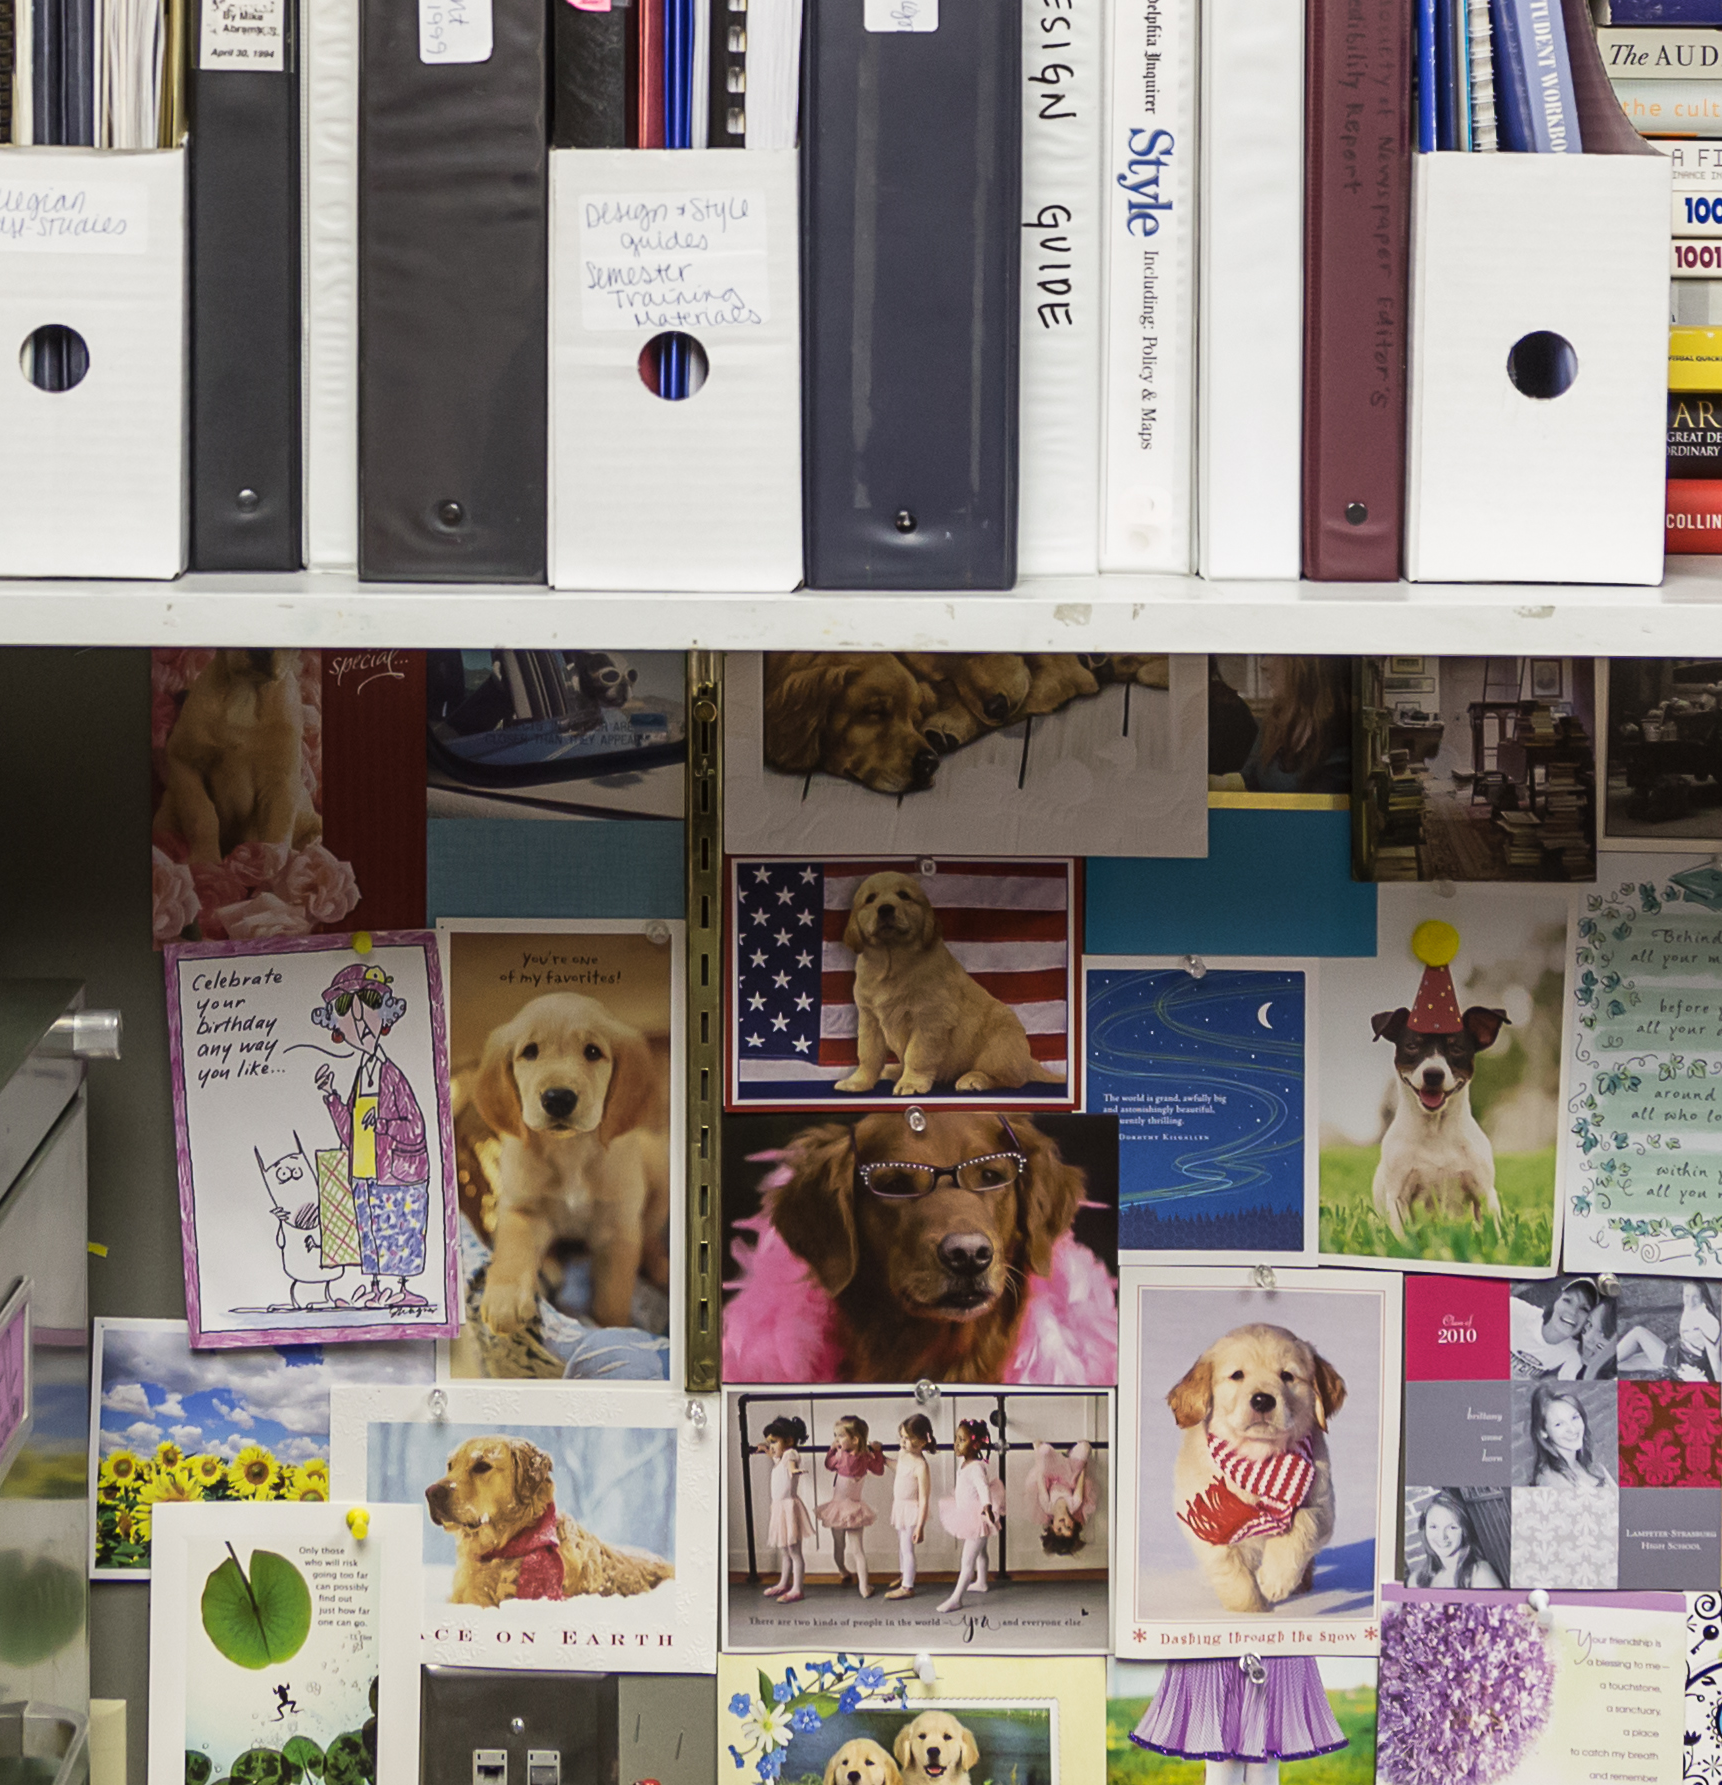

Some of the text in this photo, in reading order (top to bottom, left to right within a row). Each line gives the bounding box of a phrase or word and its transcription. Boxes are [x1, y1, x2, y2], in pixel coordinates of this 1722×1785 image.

[1609, 44, 1649, 66] The
[1143, 51, 1162, 115] Inquirer
[1624, 98, 1662, 118] the
[1674, 99, 1720, 118] cult
[1672, 149, 1684, 167] A
[1117, 127, 1176, 239] Style
[1022, 203, 1072, 331] GUIDE
[1675, 246, 1721, 268] 1001
[1143, 249, 1160, 328] Including:
[1143, 335, 1160, 384] Policy
[1140, 408, 1158, 451] Maps
[192, 970, 283, 992] Celebrate
[196, 998, 246, 1016] your
[196, 1016, 278, 1038] birthday
[196, 1038, 279, 1063] any way
[197, 1067, 233, 1089] you
[1437, 1328, 1478, 1345] 2010
[495, 1629, 674, 1647] ON EARTH
[1160, 1628, 1357, 1649] Dashing through the Snow
